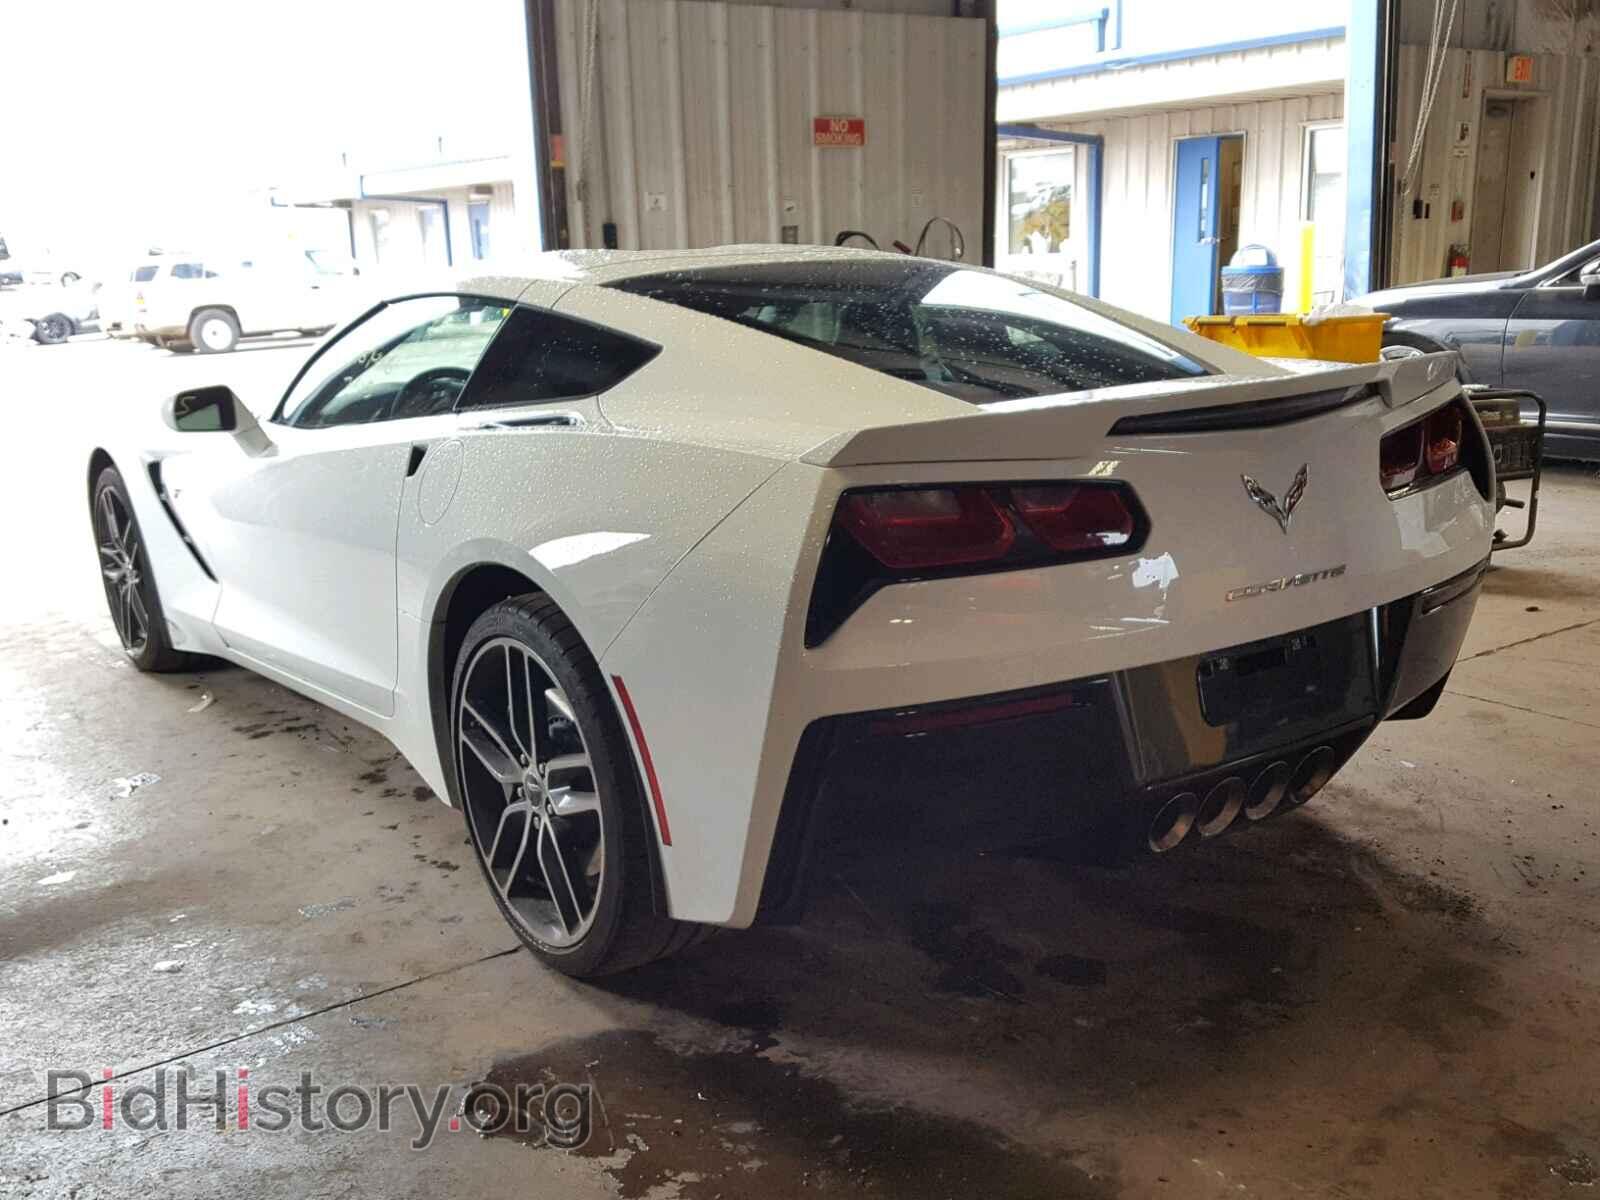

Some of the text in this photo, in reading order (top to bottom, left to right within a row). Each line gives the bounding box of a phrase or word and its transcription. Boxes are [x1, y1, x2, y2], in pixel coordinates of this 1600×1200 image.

[830, 117, 849, 132] NO
[815, 132, 863, 145] SMOKING
[1225, 564, 1346, 602] CORVETTE
